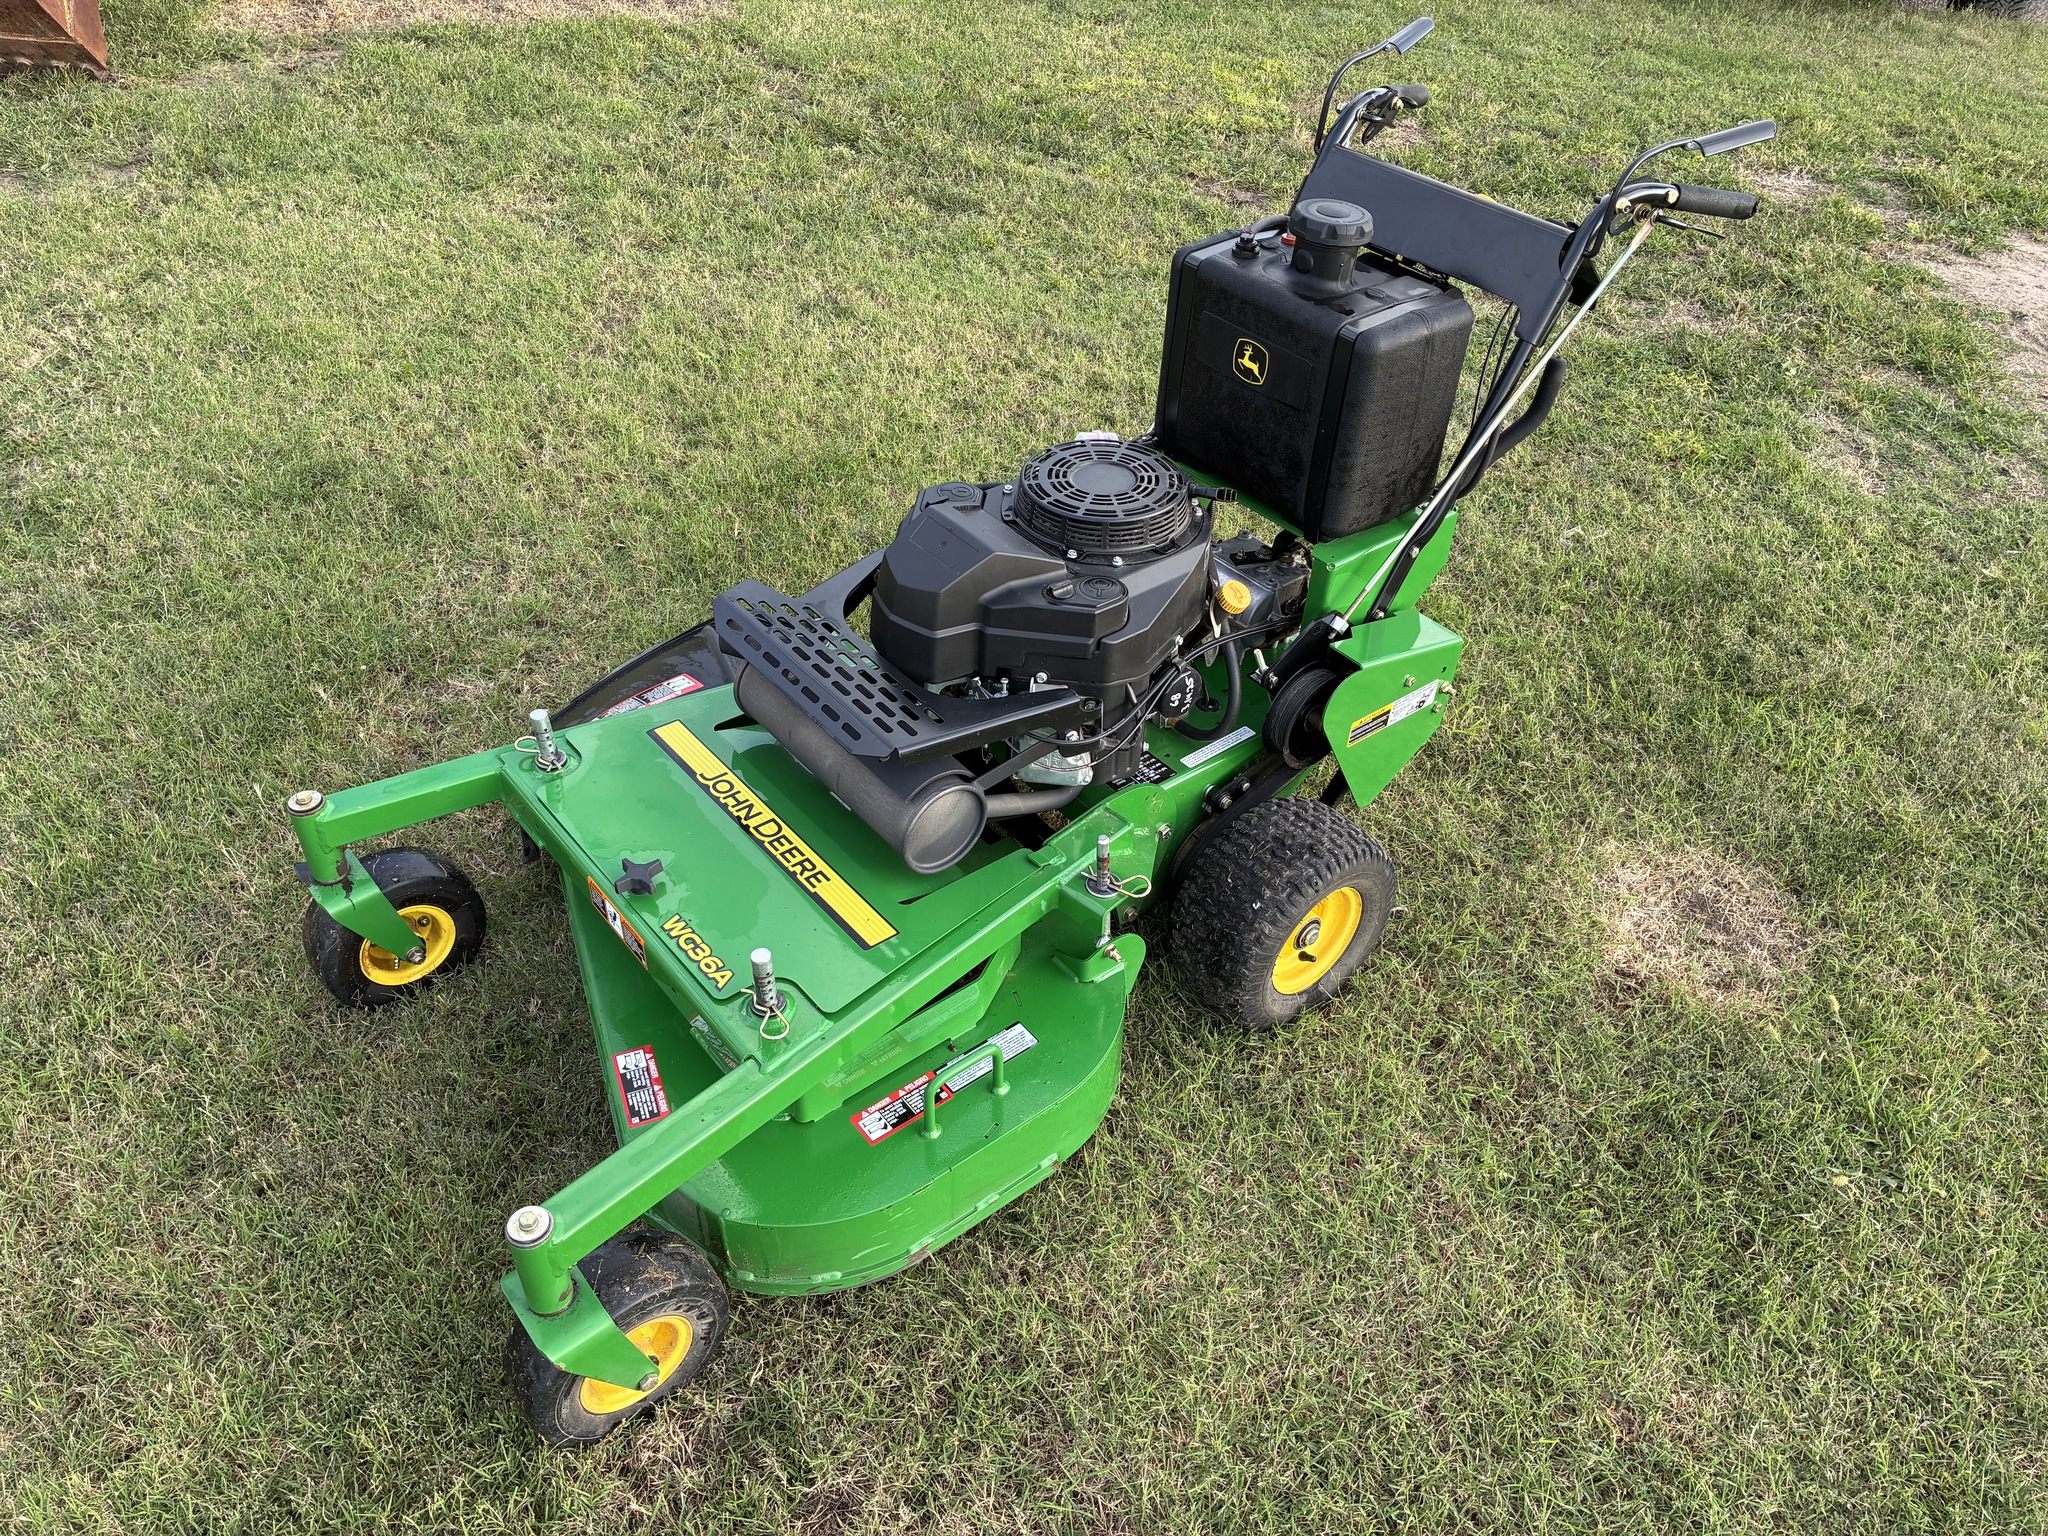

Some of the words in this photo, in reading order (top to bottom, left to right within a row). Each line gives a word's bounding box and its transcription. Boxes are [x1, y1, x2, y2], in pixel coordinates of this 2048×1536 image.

[698, 771, 763, 824] JOHN
[752, 817, 831, 889] DEERE
[661, 913, 735, 992] WG36A
[648, 1059, 659, 1078] DANGER
[656, 1091, 668, 1112] PELIGRO
[867, 1097, 892, 1113] DANGER
[905, 1075, 929, 1092] PELIGRO
